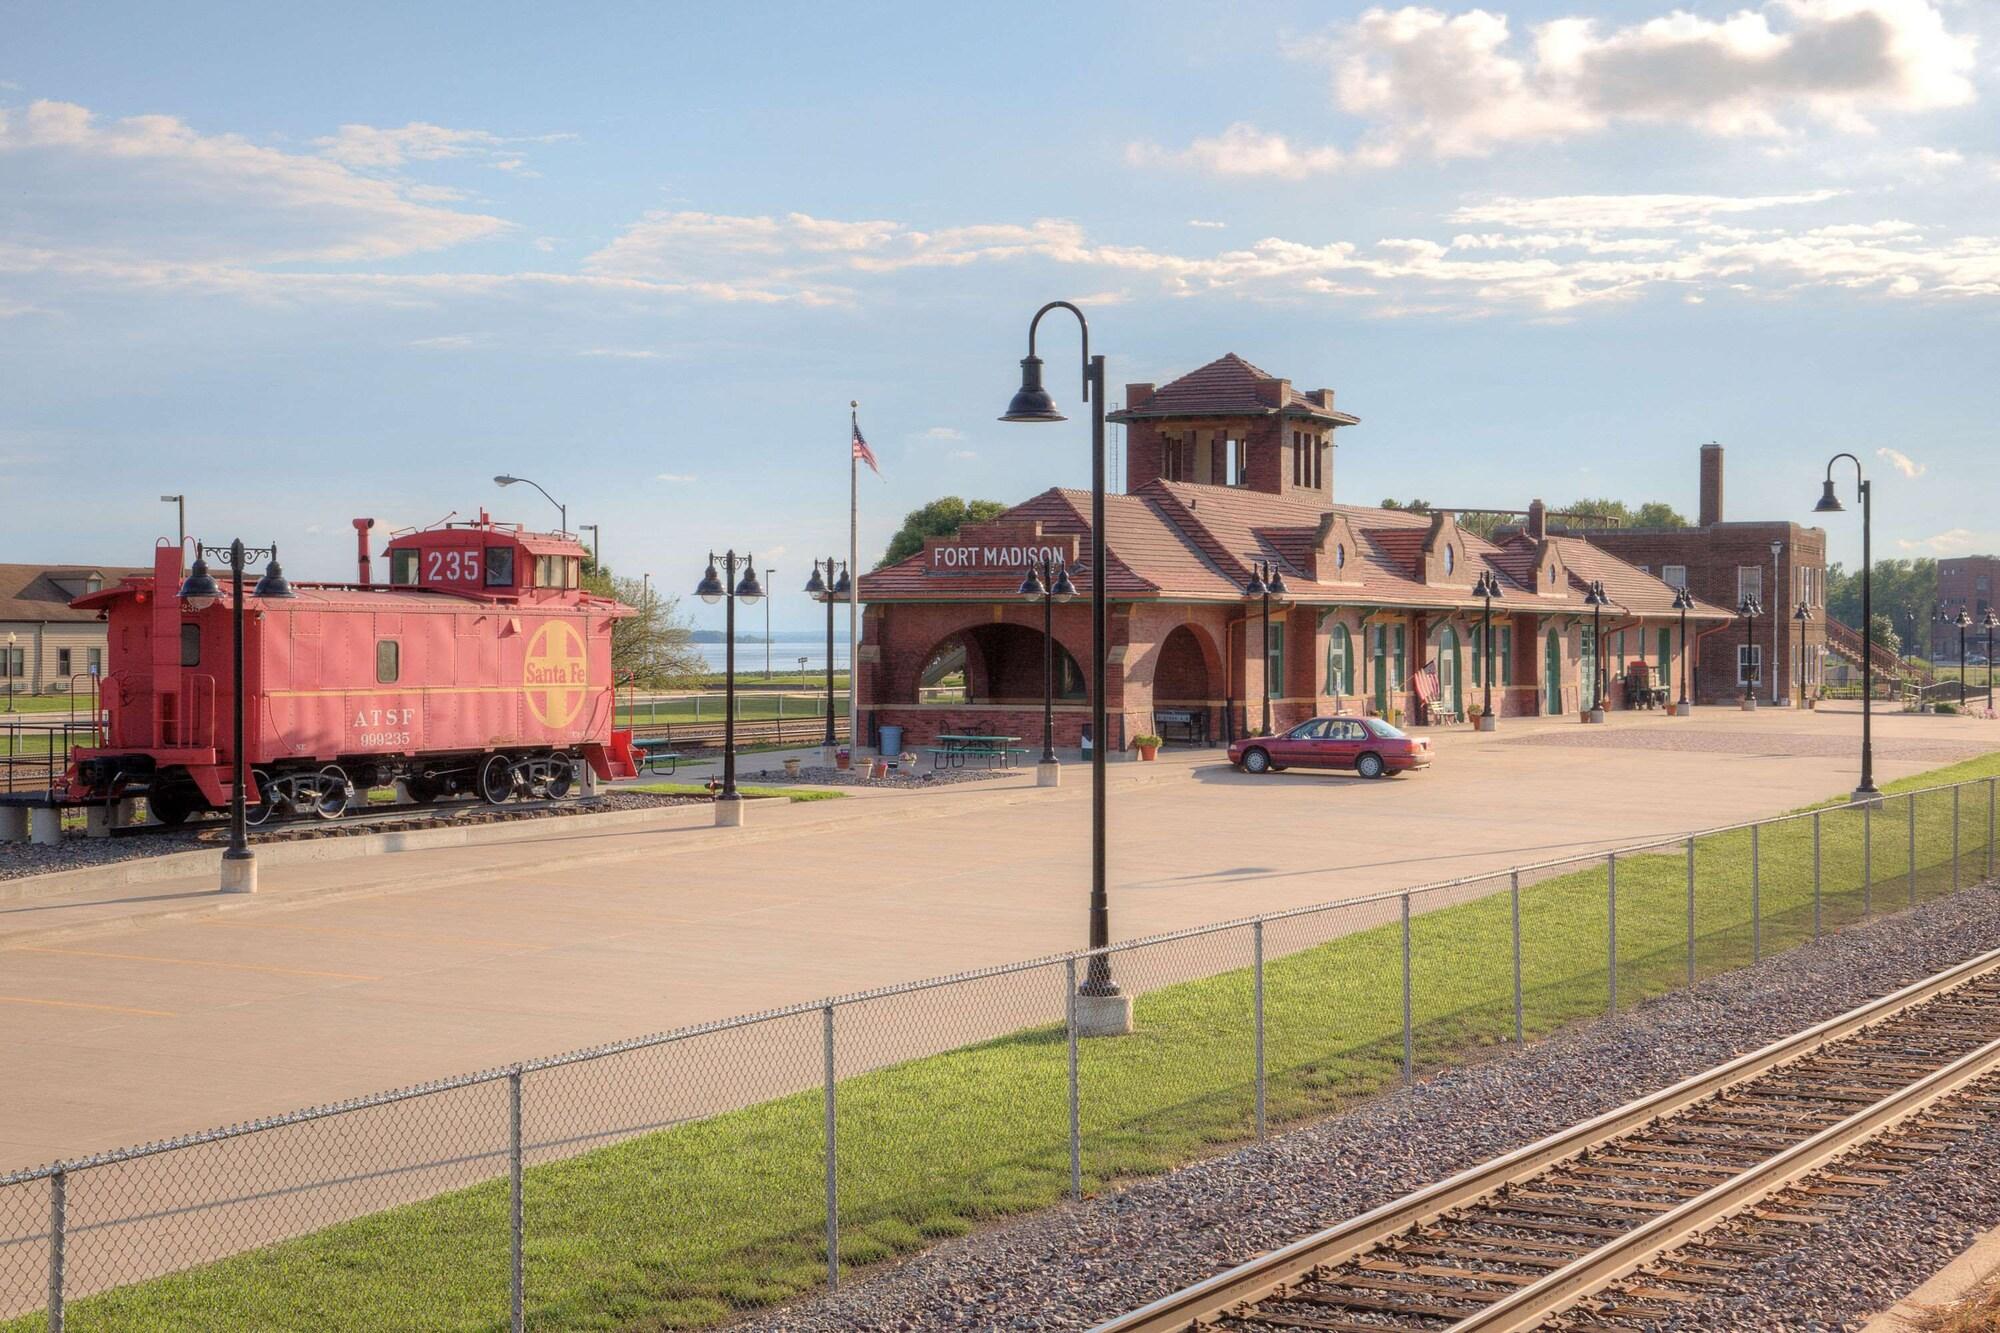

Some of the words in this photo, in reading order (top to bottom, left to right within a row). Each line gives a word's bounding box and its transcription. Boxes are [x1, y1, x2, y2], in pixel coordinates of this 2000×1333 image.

[428, 551, 479, 580] 235
[934, 547, 979, 566] FORT
[984, 546, 1064, 566] MADISON
[526, 662, 566, 684] Santa
[570, 662, 585, 683] Fe
[360, 732, 410, 747] 999235
